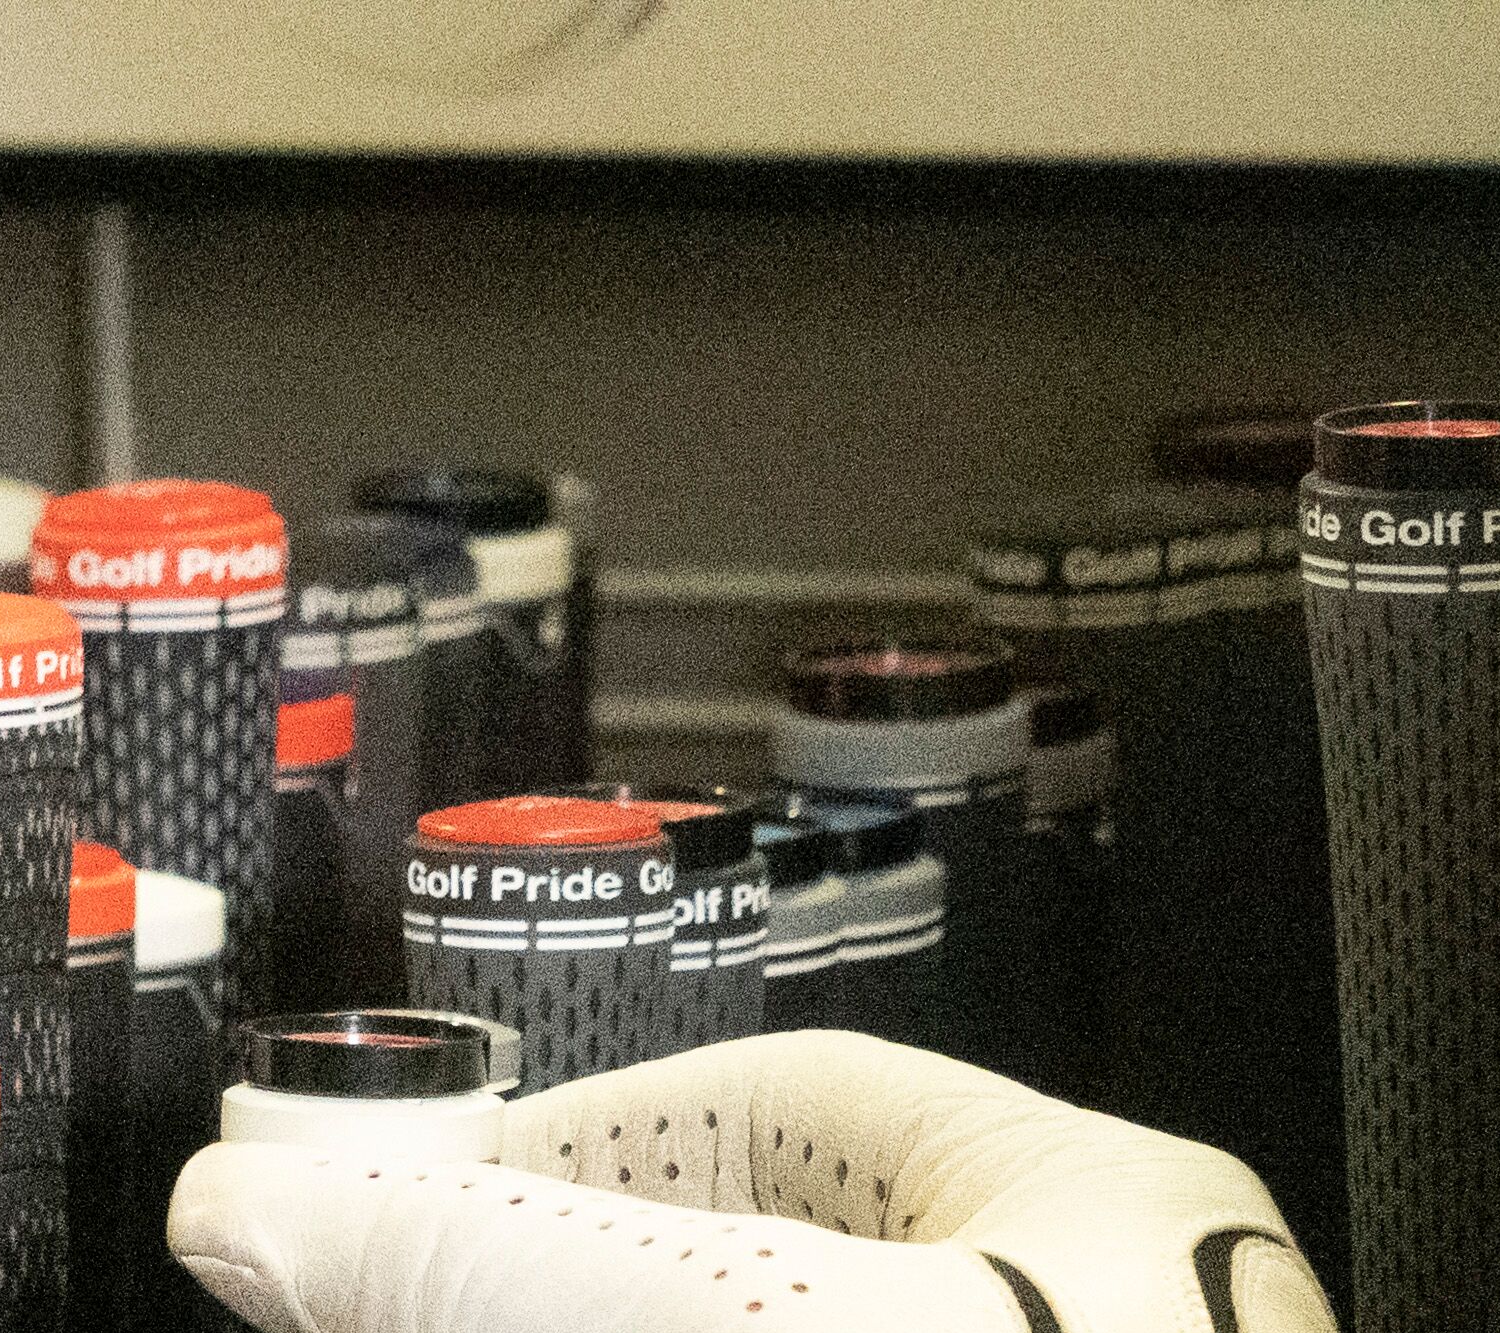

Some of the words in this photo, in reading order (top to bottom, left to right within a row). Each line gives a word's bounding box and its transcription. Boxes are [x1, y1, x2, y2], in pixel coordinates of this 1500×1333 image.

[1298, 503, 1342, 541] de
[1360, 509, 1467, 547] Golf
[67, 548, 167, 590] Golf
[406, 858, 479, 901] Golf
[491, 867, 625, 902] Pride
